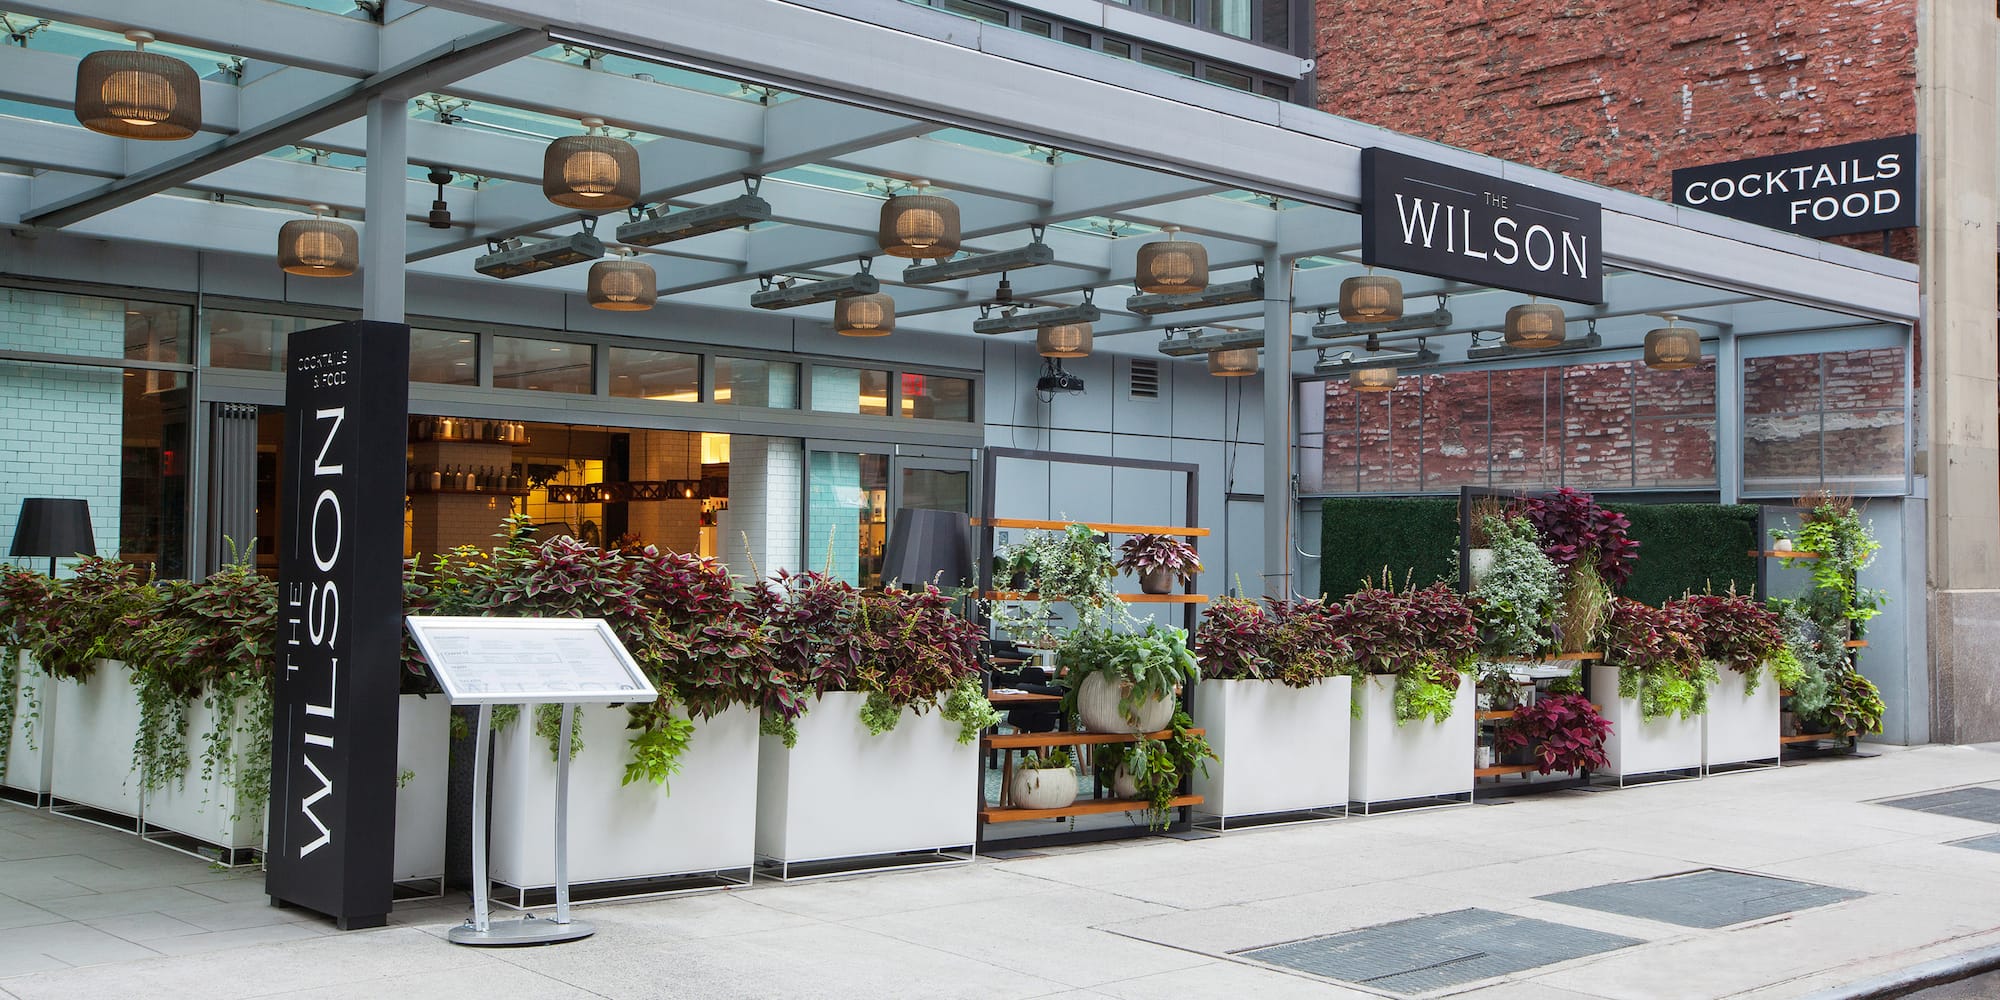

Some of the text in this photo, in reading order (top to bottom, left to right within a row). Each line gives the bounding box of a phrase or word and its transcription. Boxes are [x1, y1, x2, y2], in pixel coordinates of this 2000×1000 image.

[1483, 191, 1509, 210] THE
[1685, 153, 1901, 205] COCKTAILS
[1790, 188, 1901, 225] FOOD
[1394, 193, 1588, 280] WILSON
[297, 351, 348, 371] COCKTAILS
[322, 371, 347, 386] FOOD
[286, 582, 303, 682] THE
[299, 406, 345, 859] WILSON
